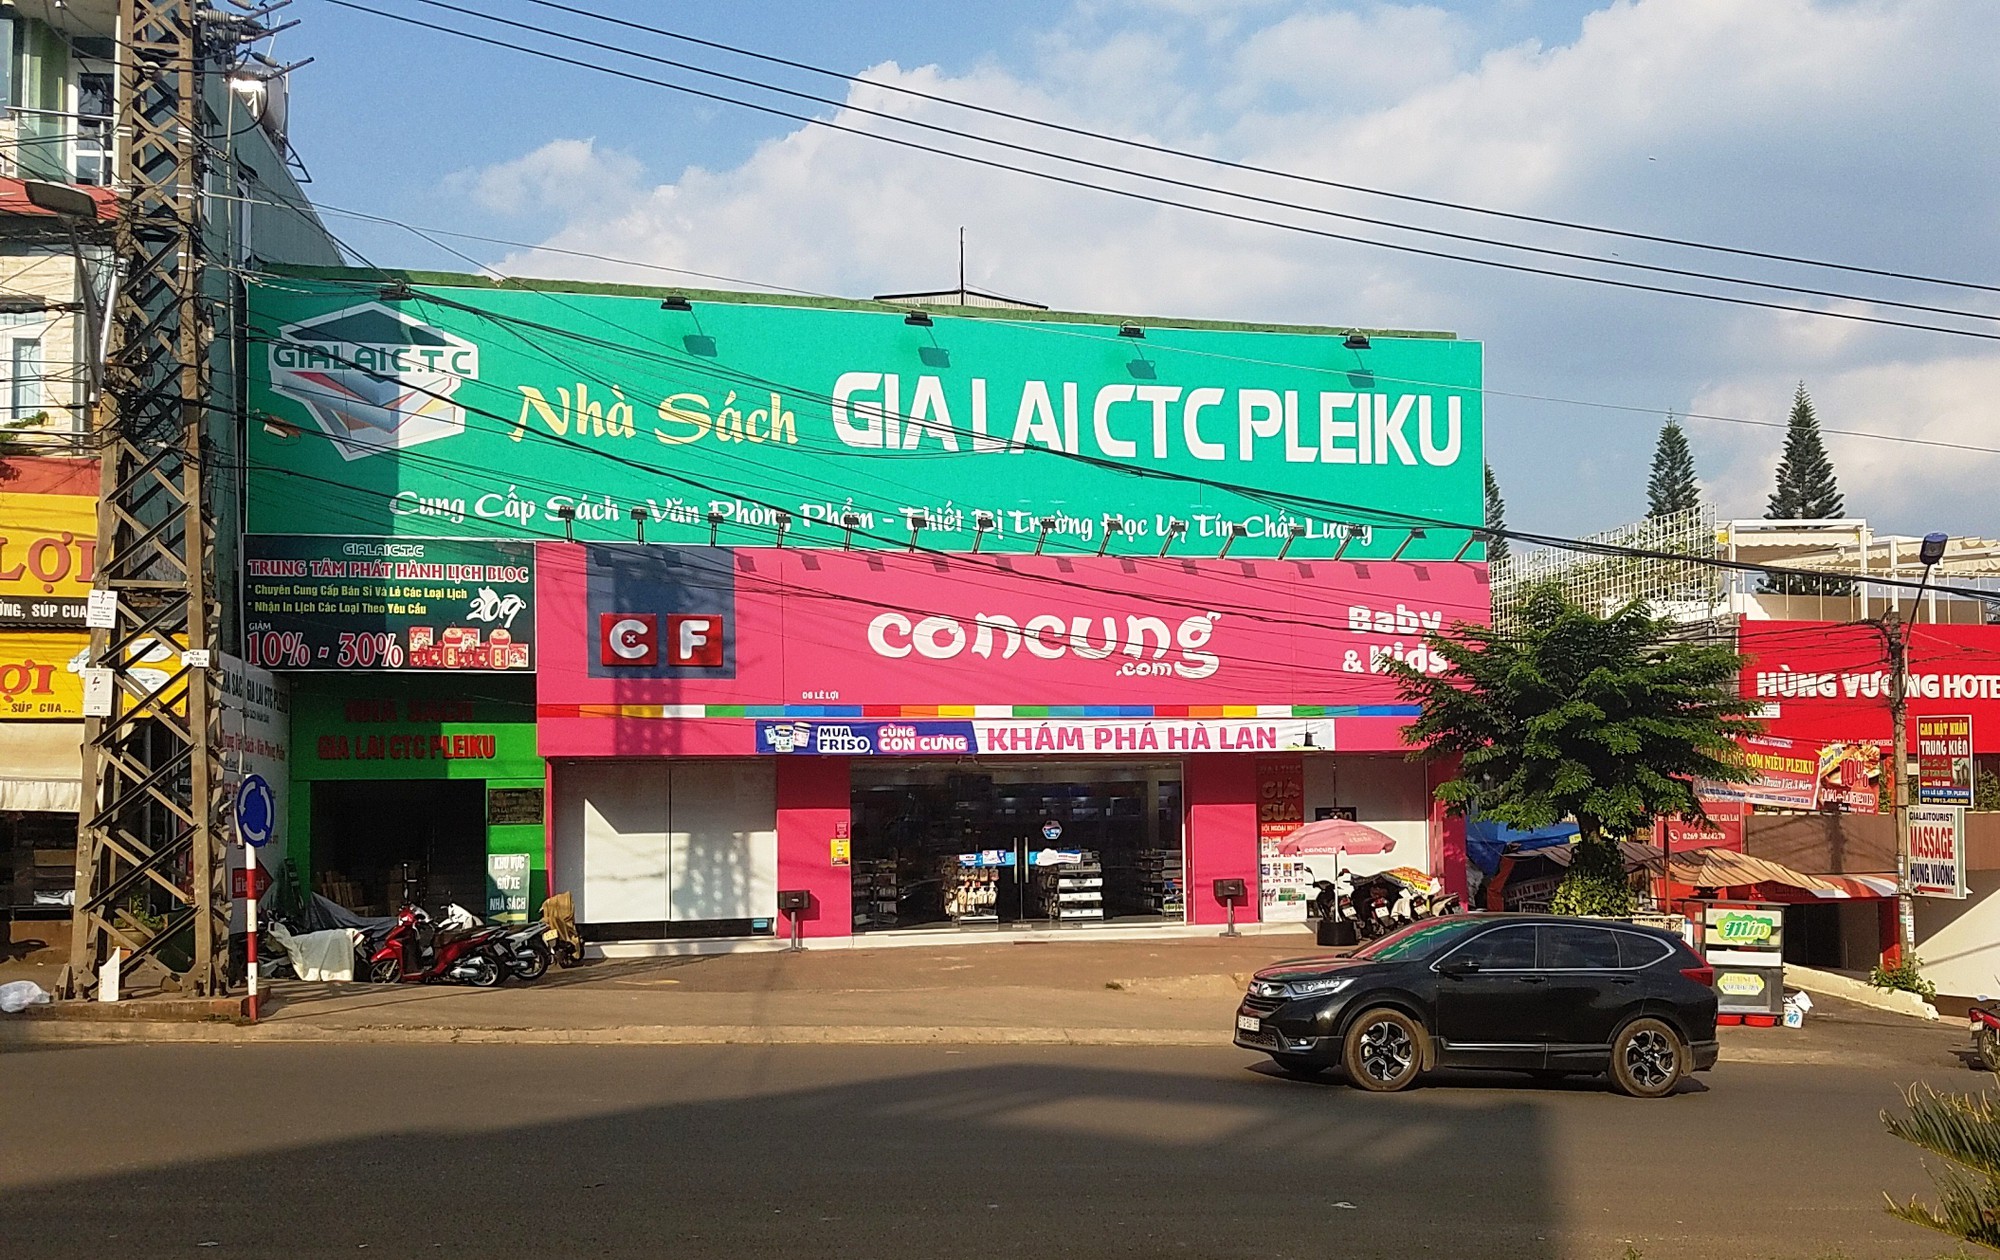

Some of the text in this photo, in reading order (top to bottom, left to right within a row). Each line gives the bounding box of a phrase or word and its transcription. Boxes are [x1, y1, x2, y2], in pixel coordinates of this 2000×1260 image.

[507, 381, 799, 447] Nhà Sách
[831, 371, 1463, 467] GIA LAI CTC PLEIKU
[389, 490, 466, 524] Cung
[474, 484, 537, 526] Cấp
[544, 494, 620, 522] Sách
[646, 497, 700, 524] Văn
[1191, 512, 1234, 538] Tín
[247, 557, 529, 584] TRUNG TÂM PHÁT HÀNH LỊCH BLOC
[254, 584, 291, 596] Chuyên
[293, 585, 318, 597] Cung
[320, 583, 339, 597] Cấp
[341, 585, 360, 597] Bán
[375, 586, 387, 597] Và
[403, 586, 422, 598] Các
[424, 587, 445, 601] Loại
[446, 588, 468, 601] Lịch
[31, 600, 58, 618] SÚP
[62, 604, 88, 618] CUA
[254, 601, 281, 614] Nhận
[283, 602, 293, 613] In
[294, 602, 316, 616] Lịch
[318, 601, 337, 613] Các
[339, 602, 360, 616] Loại
[362, 602, 386, 614] Theo
[387, 602, 406, 614] Yêu
[466, 585, 527, 629] 2019
[1348, 603, 1443, 641] Baby
[247, 631, 311, 667] 10%
[337, 632, 404, 668] 30%
[679, 618, 710, 660] F
[1342, 649, 1365, 673] &
[1756, 664, 1837, 698] HÙNG
[819, 726, 850, 738] MUA
[880, 723, 916, 737] CÙNG
[880, 733, 968, 751] CON CƯNG
[987, 721, 1278, 750] KHÁM PHÁ HÀ LAN
[429, 733, 497, 760] PLEIKU
[1920, 739, 1947, 756] TRUNG
[1746, 750, 1764, 769] CƠM
[1785, 757, 1815, 775] PLEIKU
[1909, 811, 1953, 822] GIALAITOURIST
[1910, 825, 1954, 861] MASSAGE
[506, 894, 526, 910] SÁCH
